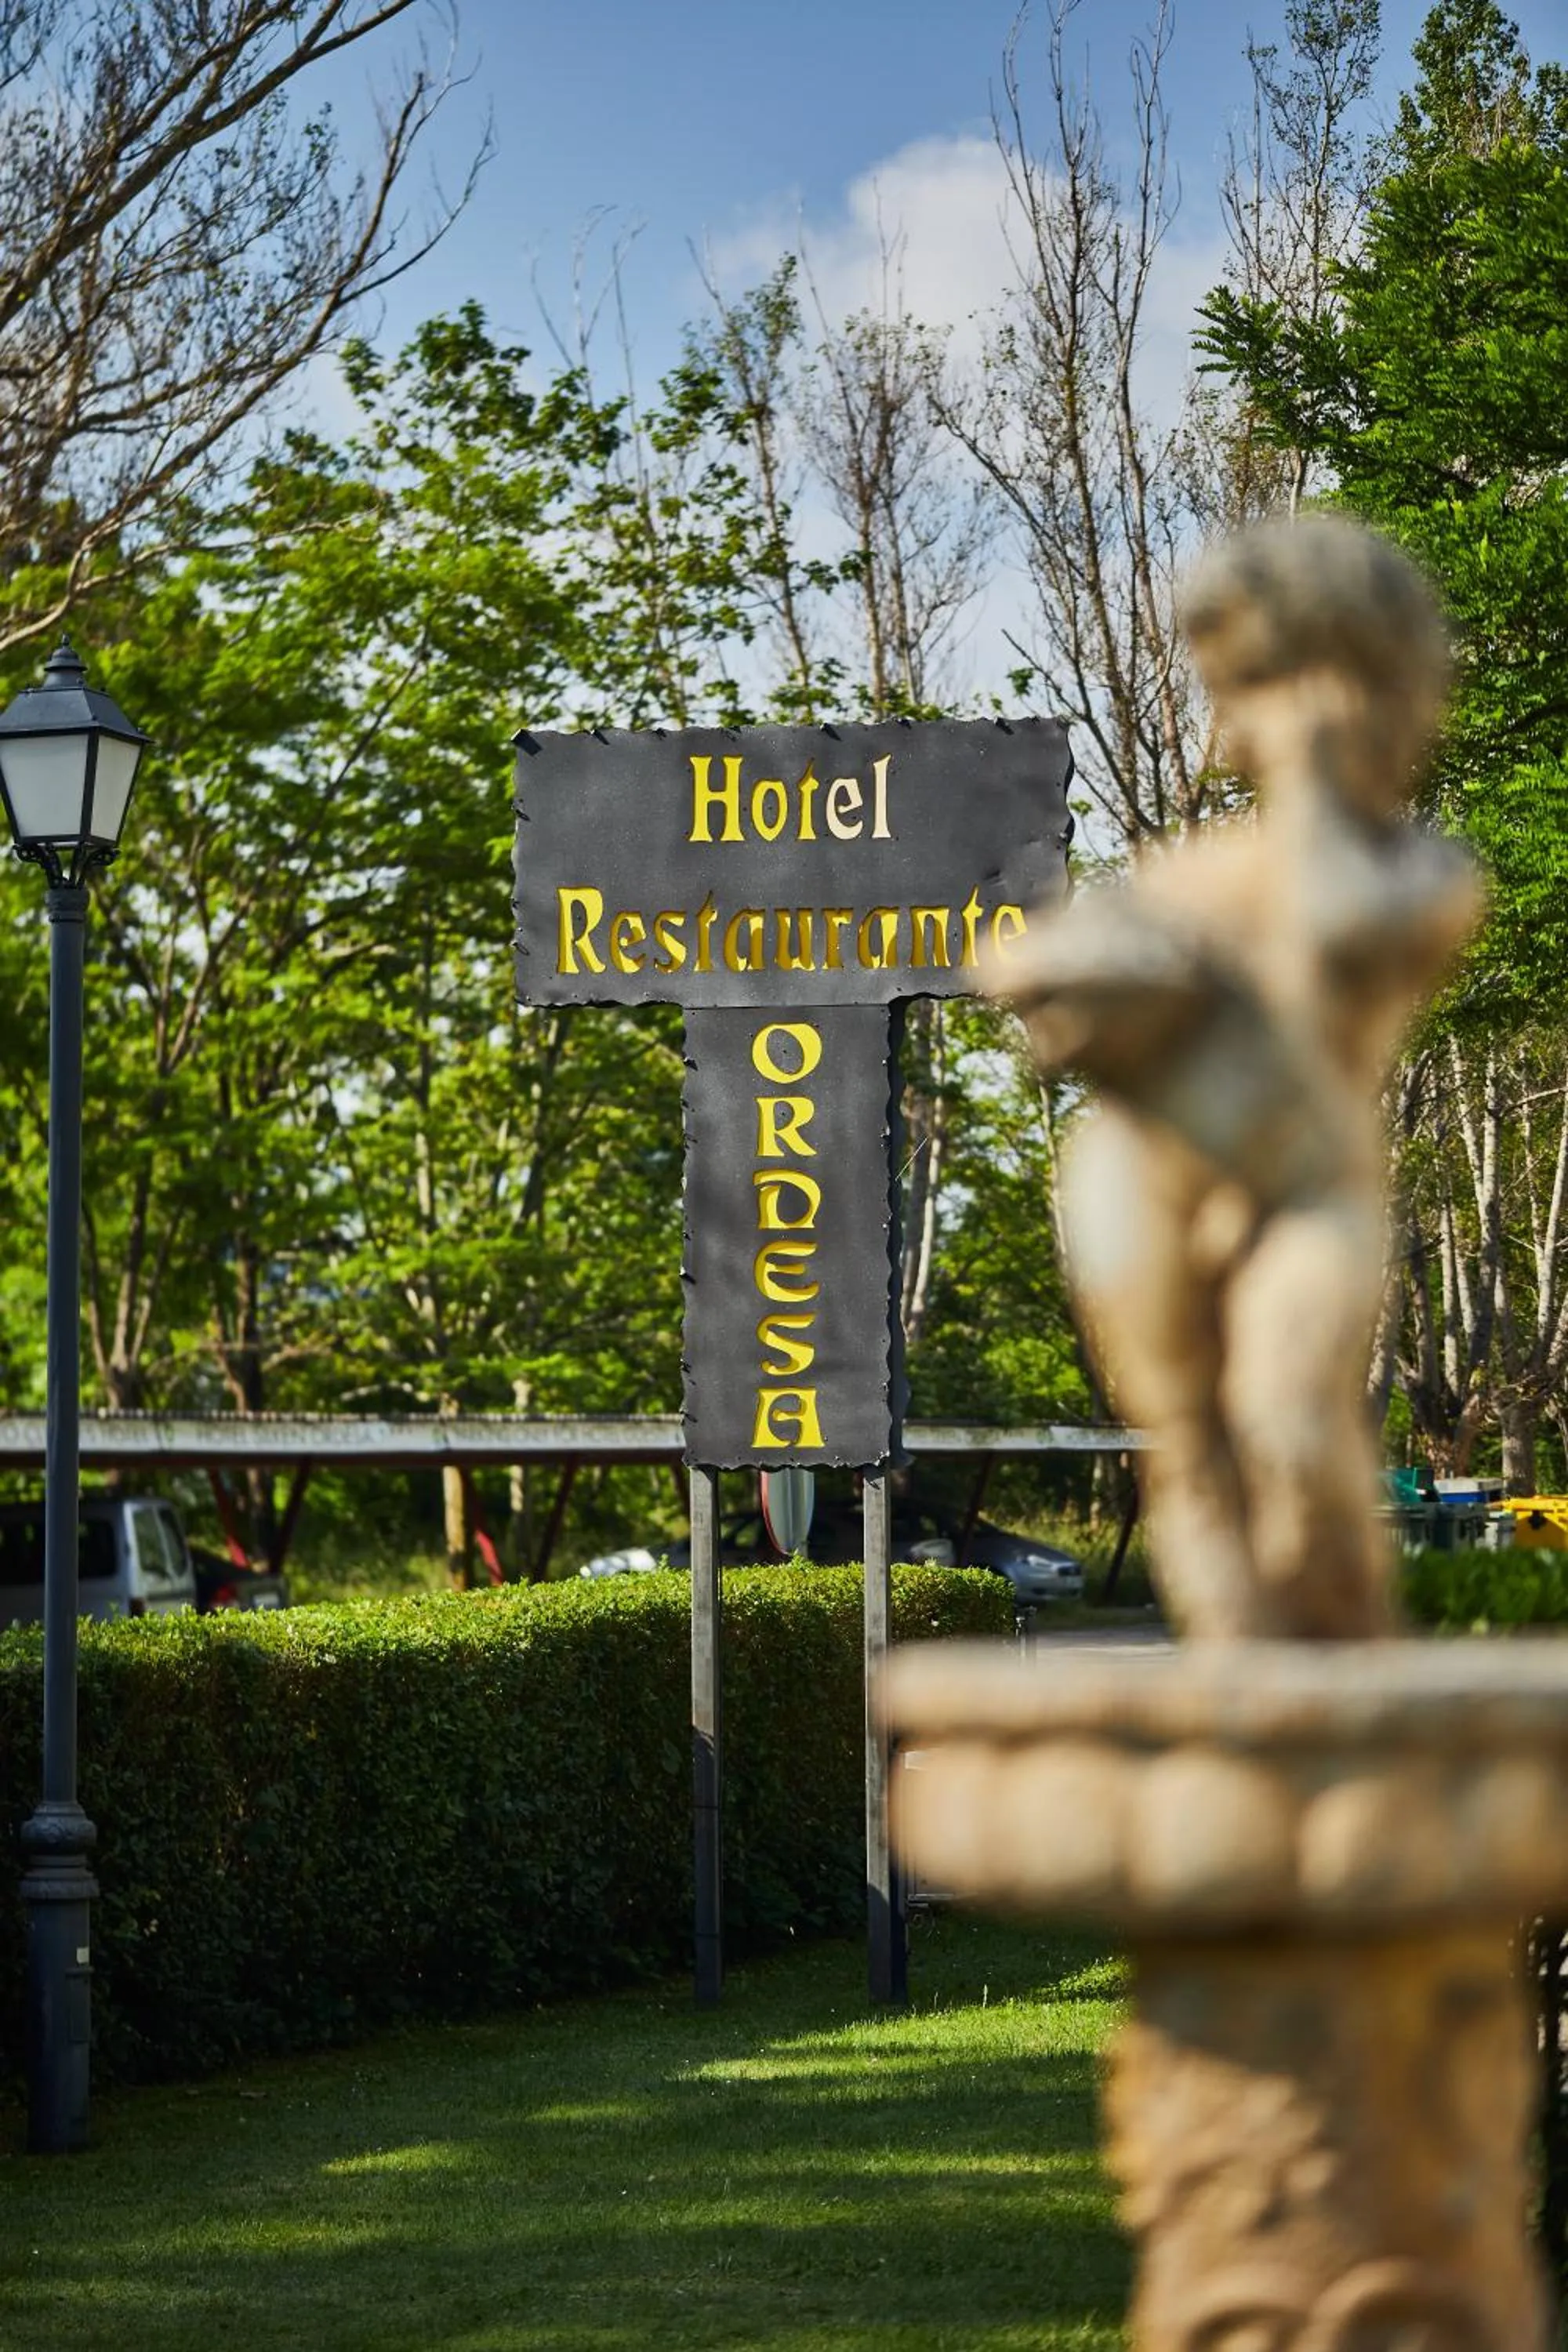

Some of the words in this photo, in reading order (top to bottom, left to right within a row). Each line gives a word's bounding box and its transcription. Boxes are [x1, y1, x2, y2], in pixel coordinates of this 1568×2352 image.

[688, 753, 892, 843] Hotel
[556, 884, 1029, 975] Restaurante
[750, 1022, 826, 1449] ORDESA
